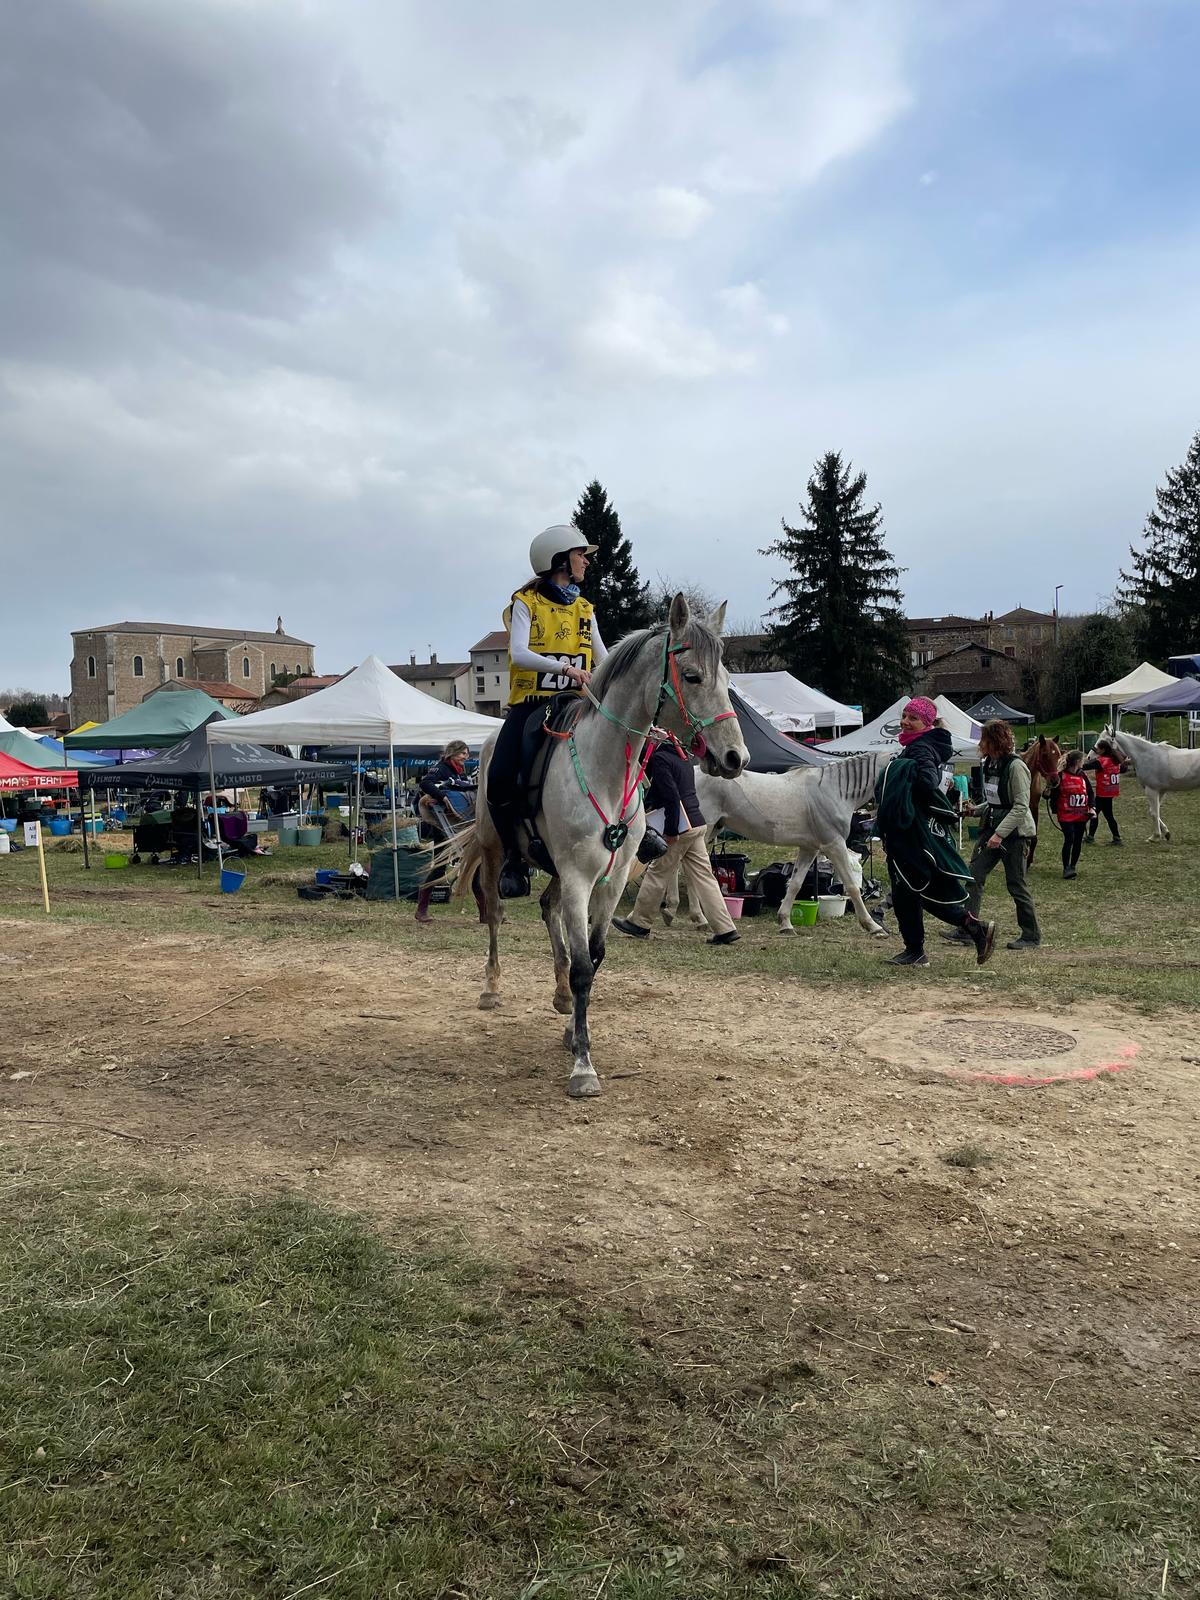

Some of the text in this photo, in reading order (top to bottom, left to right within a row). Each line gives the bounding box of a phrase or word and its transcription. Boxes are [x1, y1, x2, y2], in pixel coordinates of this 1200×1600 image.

[0, 776, 62, 787] MA'S TEAM
[155, 776, 183, 785] XLMOTO
[228, 775, 263, 783] XLMOTO
[1111, 774, 1119, 784] 01
[1070, 795, 1086, 806] 022
